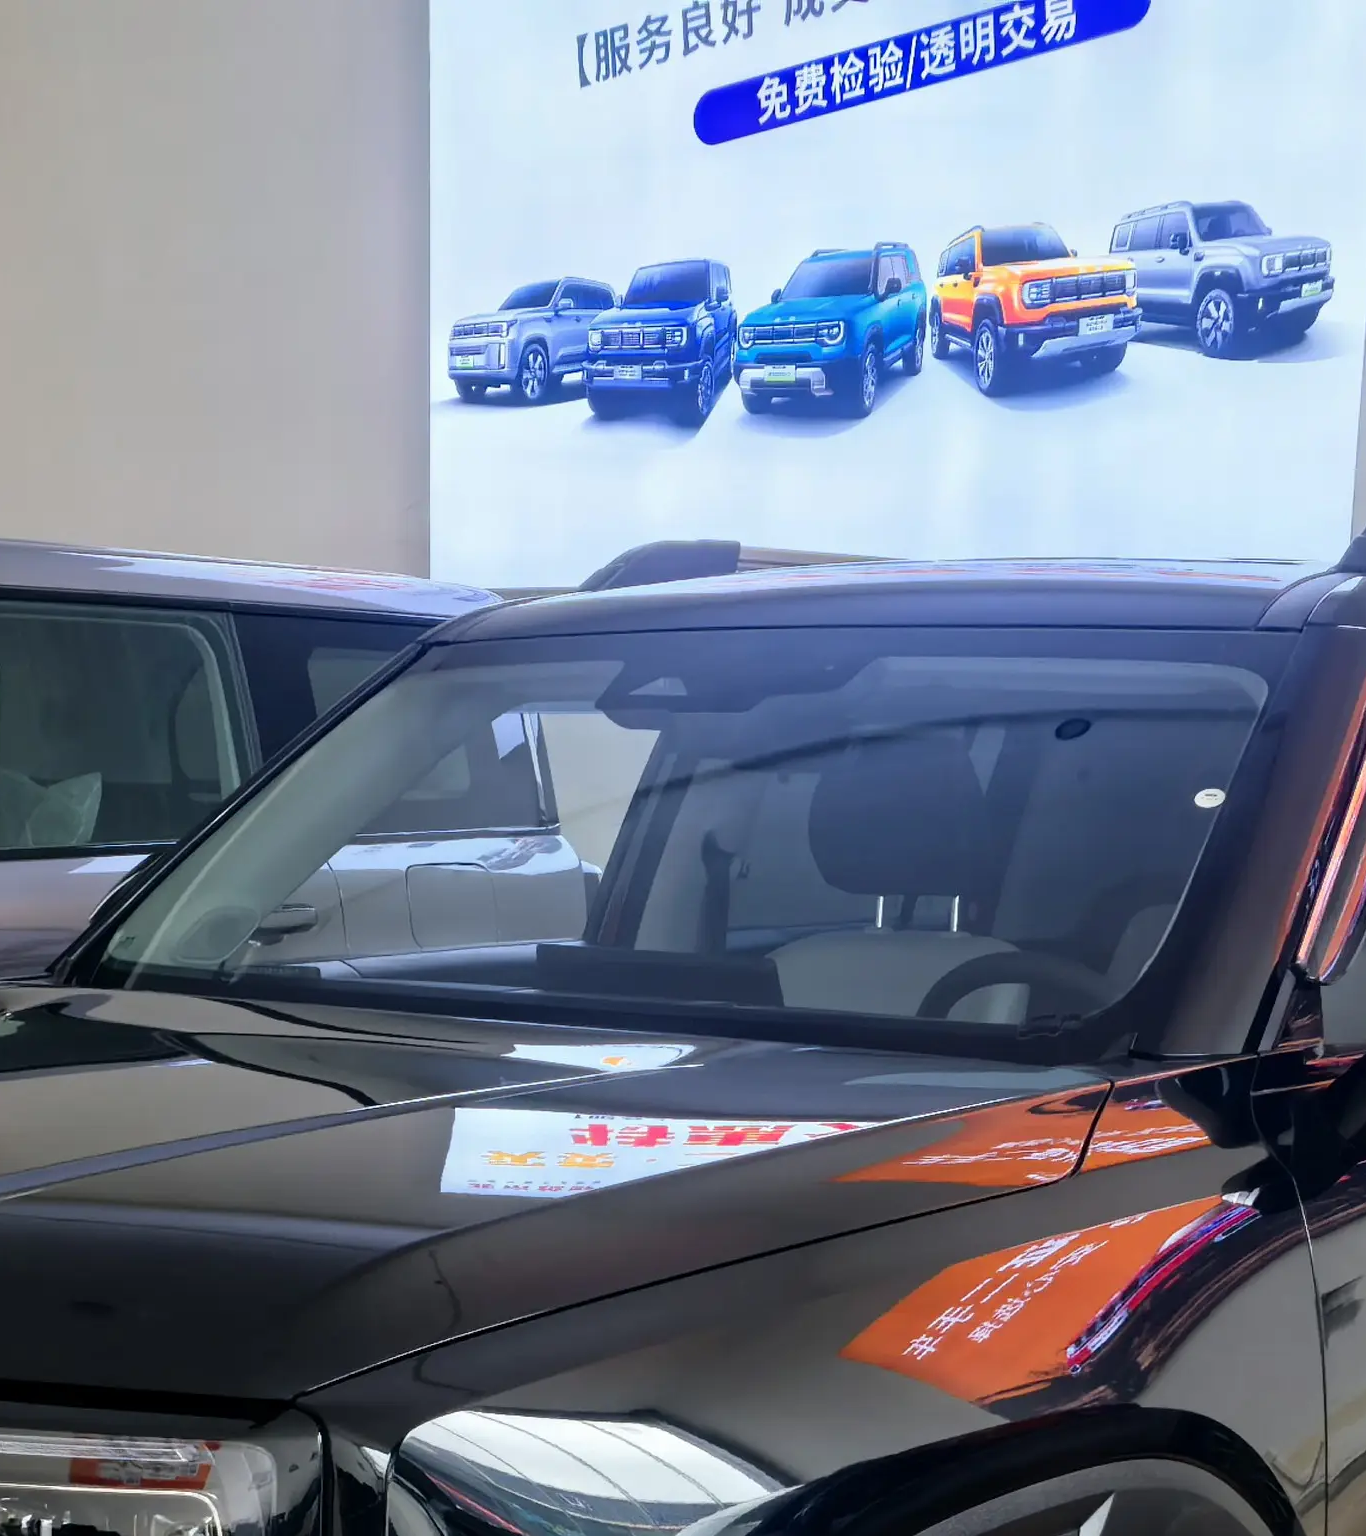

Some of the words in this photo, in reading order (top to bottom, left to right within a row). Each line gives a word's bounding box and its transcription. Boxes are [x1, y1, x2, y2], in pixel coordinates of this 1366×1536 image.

[756, 0, 1078, 125] 免费检验/透明交易
